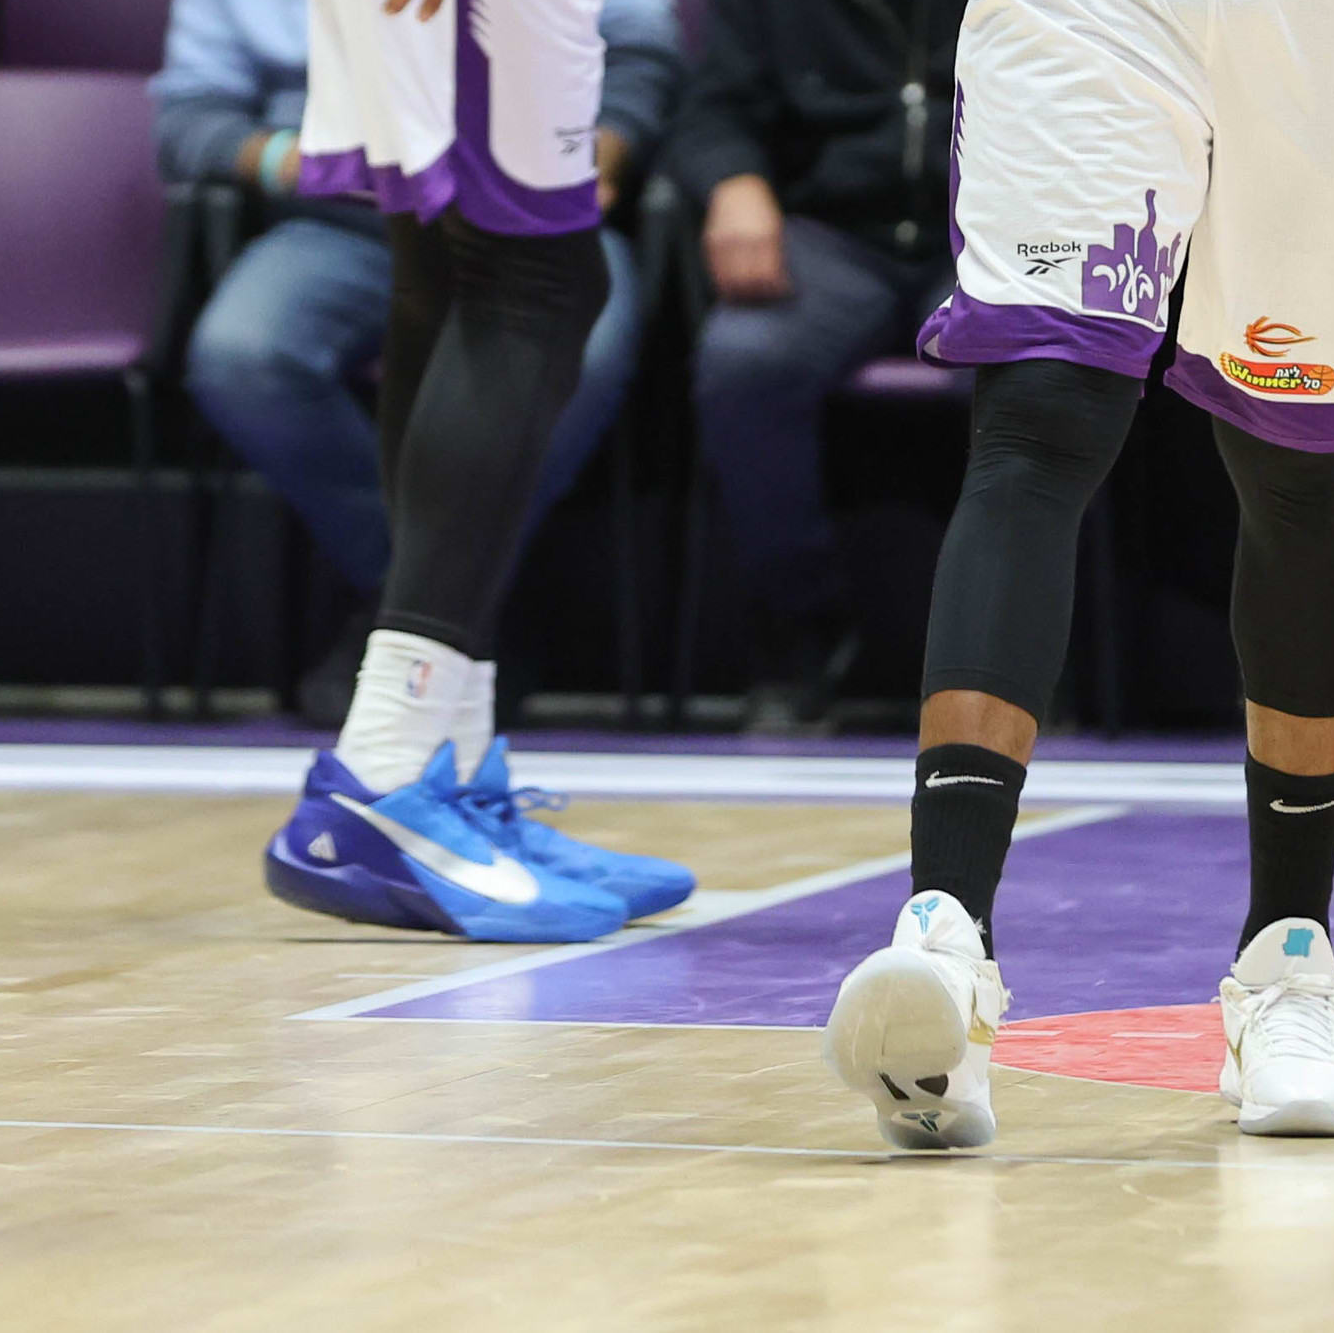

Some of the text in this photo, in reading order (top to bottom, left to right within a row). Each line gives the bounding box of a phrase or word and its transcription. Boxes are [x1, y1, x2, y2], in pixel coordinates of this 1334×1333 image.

[1016, 241, 1082, 257] Reebok
[1228, 360, 1302, 389] Winner
[1274, 365, 1301, 378] ליגת
[1303, 375, 1322, 390] סל
